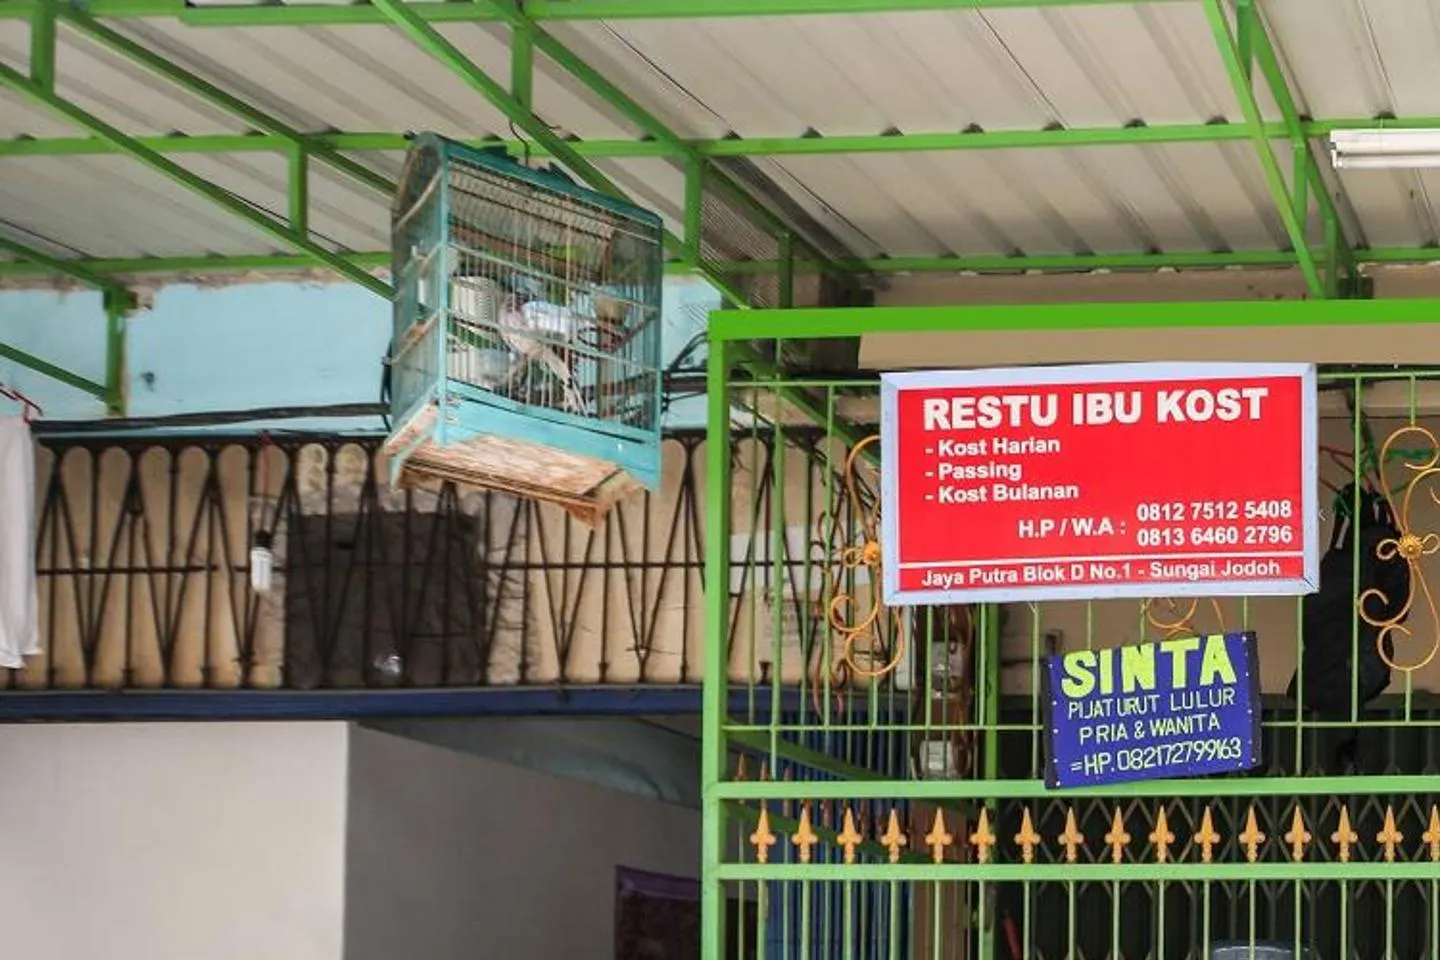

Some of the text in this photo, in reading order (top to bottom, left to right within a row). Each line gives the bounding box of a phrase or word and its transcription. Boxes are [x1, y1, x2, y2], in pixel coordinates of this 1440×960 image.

[924, 387, 1268, 430] RESTU IBU KOST
[938, 439, 987, 457] Kost
[993, 436, 1060, 454] Harian
[938, 461, 1022, 481] Passing
[938, 485, 987, 503] Kost
[993, 483, 1079, 501] Bulanan
[1136, 500, 1292, 521] 0812 7512 5408
[1018, 519, 1054, 538] H.P
[1136, 525, 1292, 546] 0813 6460 2796
[922, 570, 964, 589] Jaya
[969, 567, 1018, 584] Putra
[1023, 565, 1065, 582] Blok
[1071, 564, 1084, 580] D
[1090, 563, 1131, 580] No.1
[1151, 561, 1214, 581] Sungai
[1221, 559, 1280, 577] Jodoh
[1061, 634, 1237, 698] SINTA
[1170, 688, 1235, 712] LULUR
[1079, 712, 1220, 746] PRIA & WANITA
